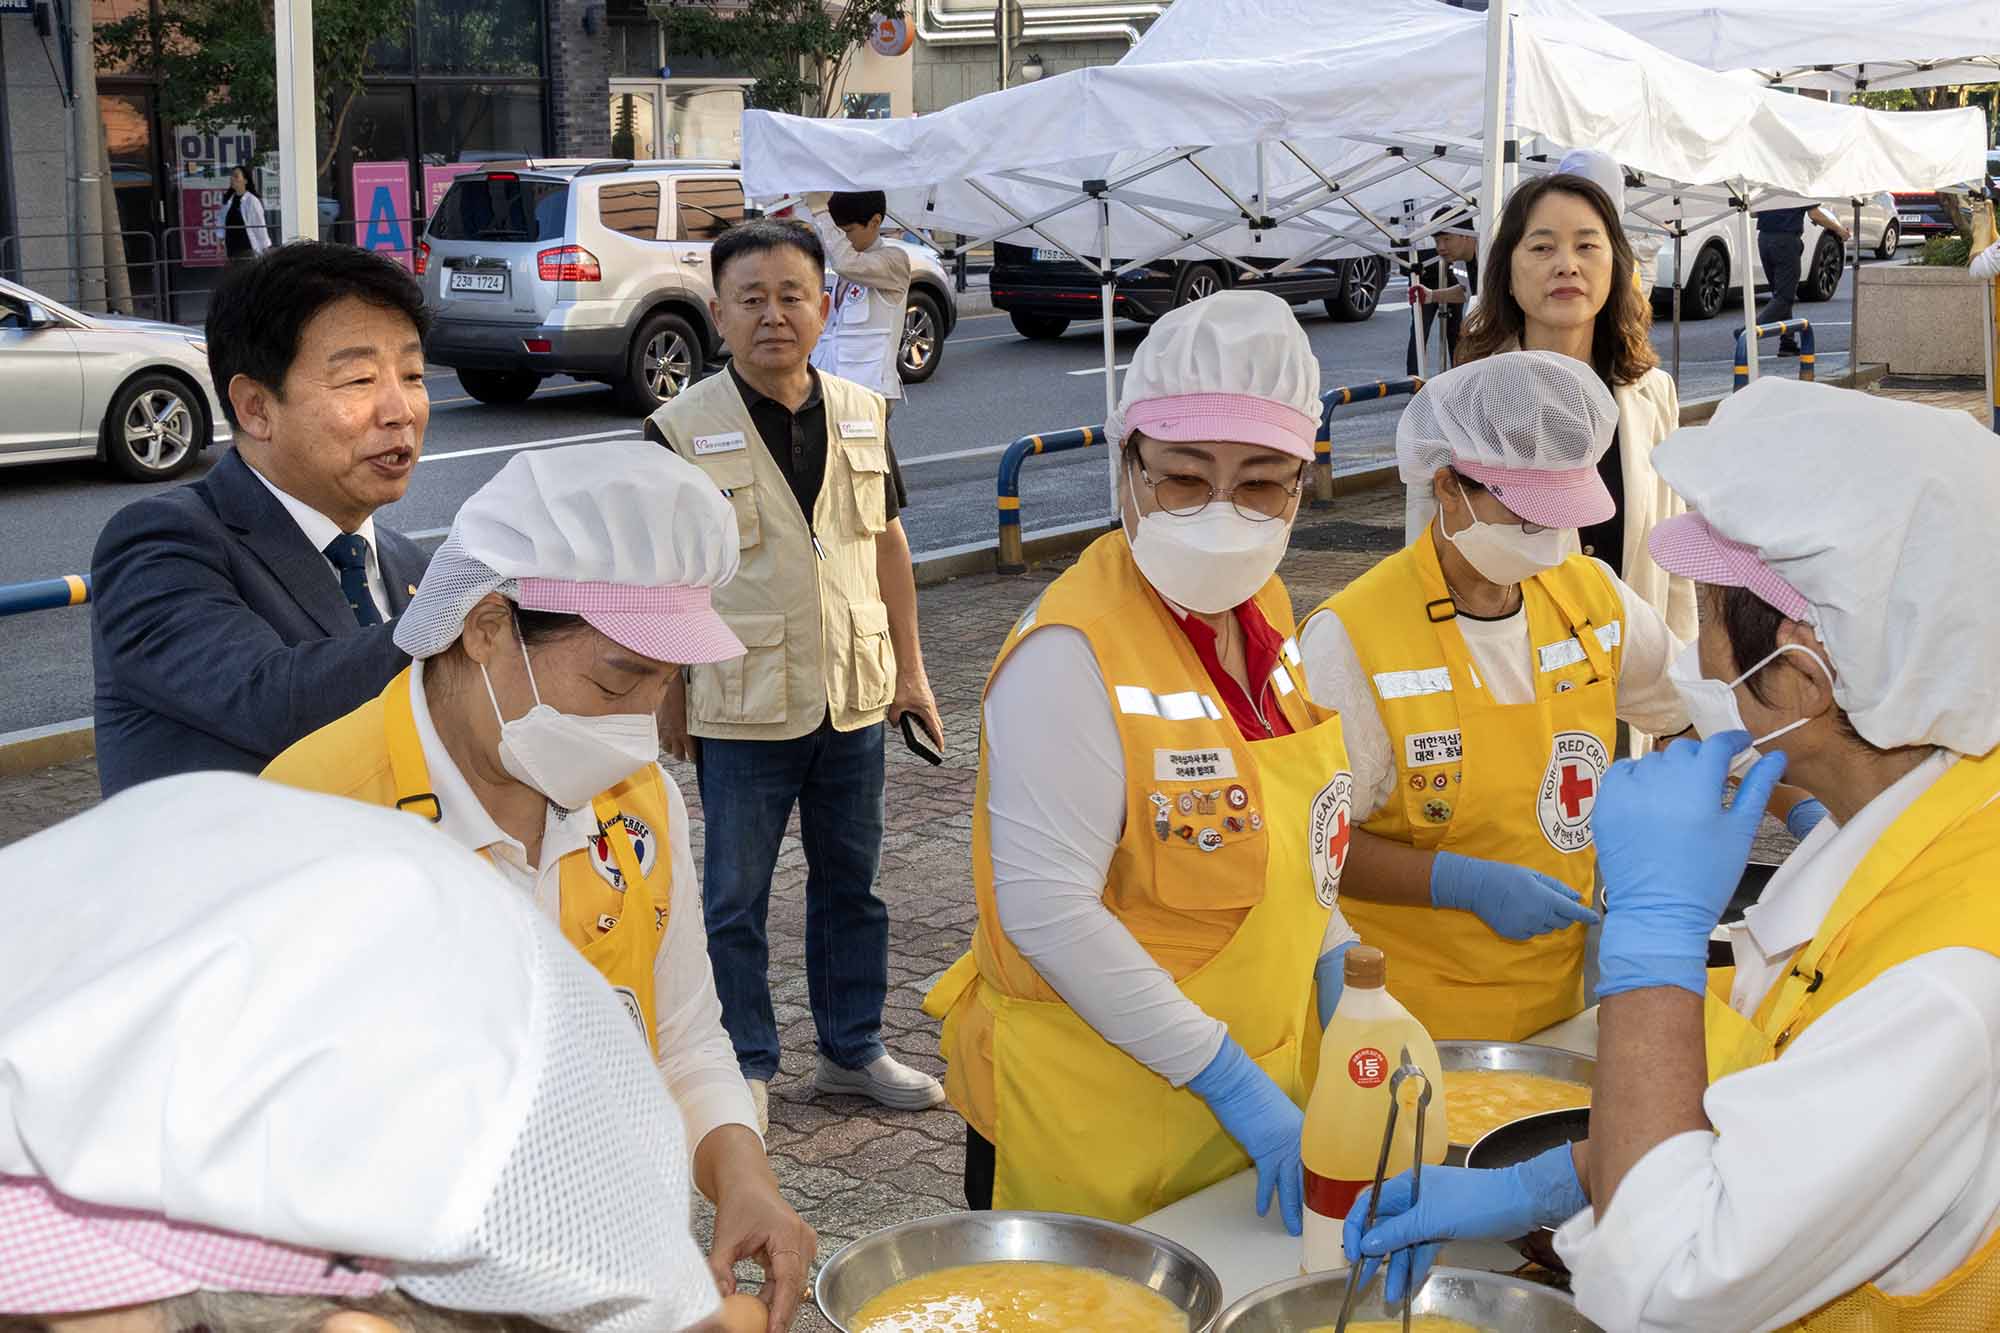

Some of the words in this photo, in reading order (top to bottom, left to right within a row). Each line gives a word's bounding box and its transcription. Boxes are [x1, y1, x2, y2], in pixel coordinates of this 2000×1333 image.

[365, 186, 405, 251] A
[477, 276, 499, 288] 1724
[1413, 732, 1462, 750] 대한적십
[1415, 750, 1434, 762] 대전
[1558, 740, 1585, 754] RED
[1586, 744, 1606, 776] CROS
[623, 817, 649, 839] CROSS
[1315, 791, 1337, 855] KOREAN
[1356, 1058, 1380, 1077] 1등
